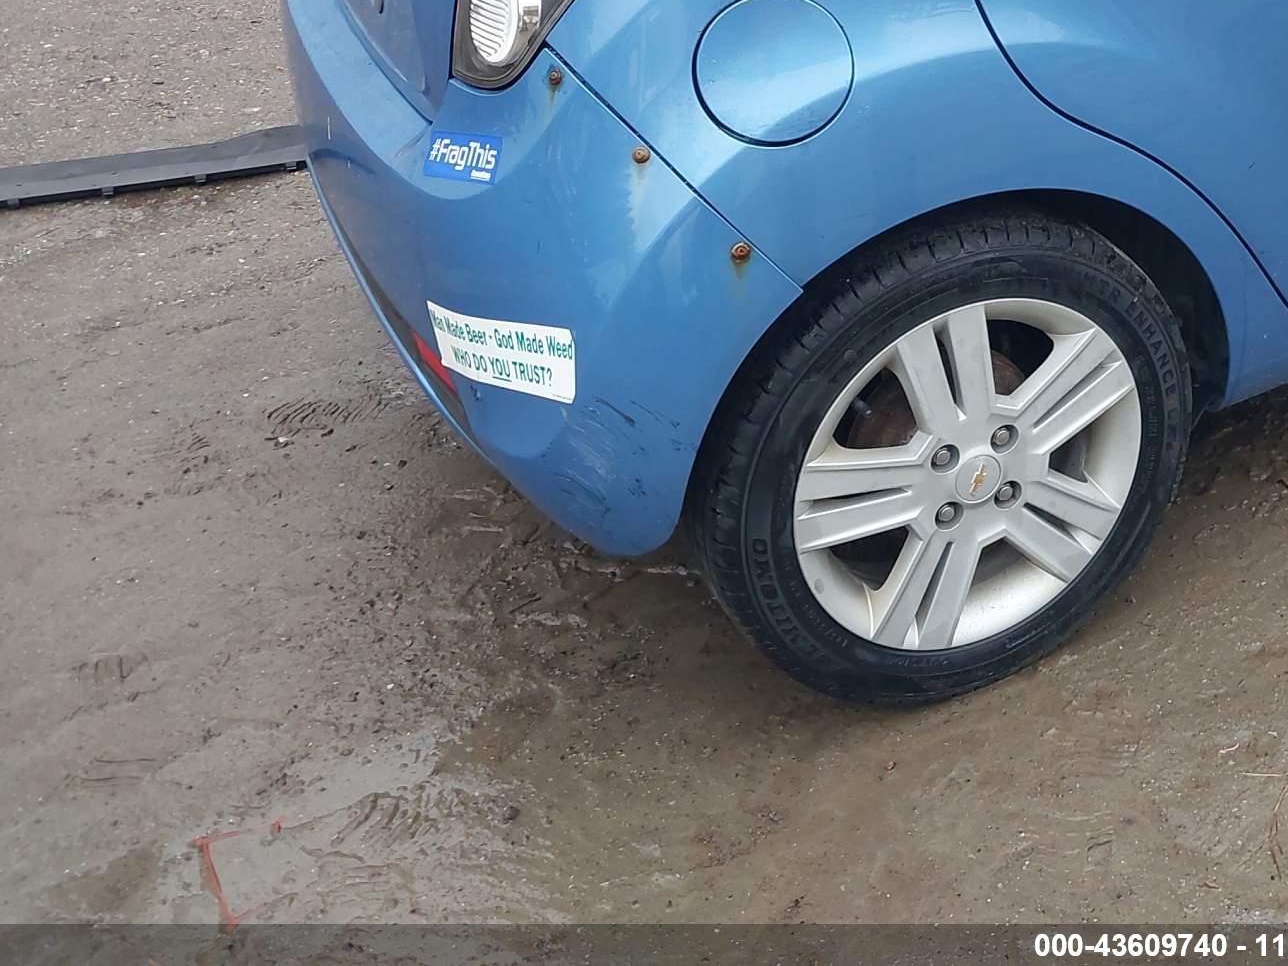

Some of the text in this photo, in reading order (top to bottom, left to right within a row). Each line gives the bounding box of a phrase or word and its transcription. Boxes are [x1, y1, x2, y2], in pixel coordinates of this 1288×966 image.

[429, 137, 498, 171] #FragThis
[444, 316, 466, 341] Made
[465, 322, 488, 347] Beer
[494, 328, 515, 351] God
[515, 331, 544, 356] Made
[546, 336, 573, 361] Weed
[1124, 301, 1178, 399] ENHANCE
[452, 346, 553, 387] WHO DO YOU TRUST?
